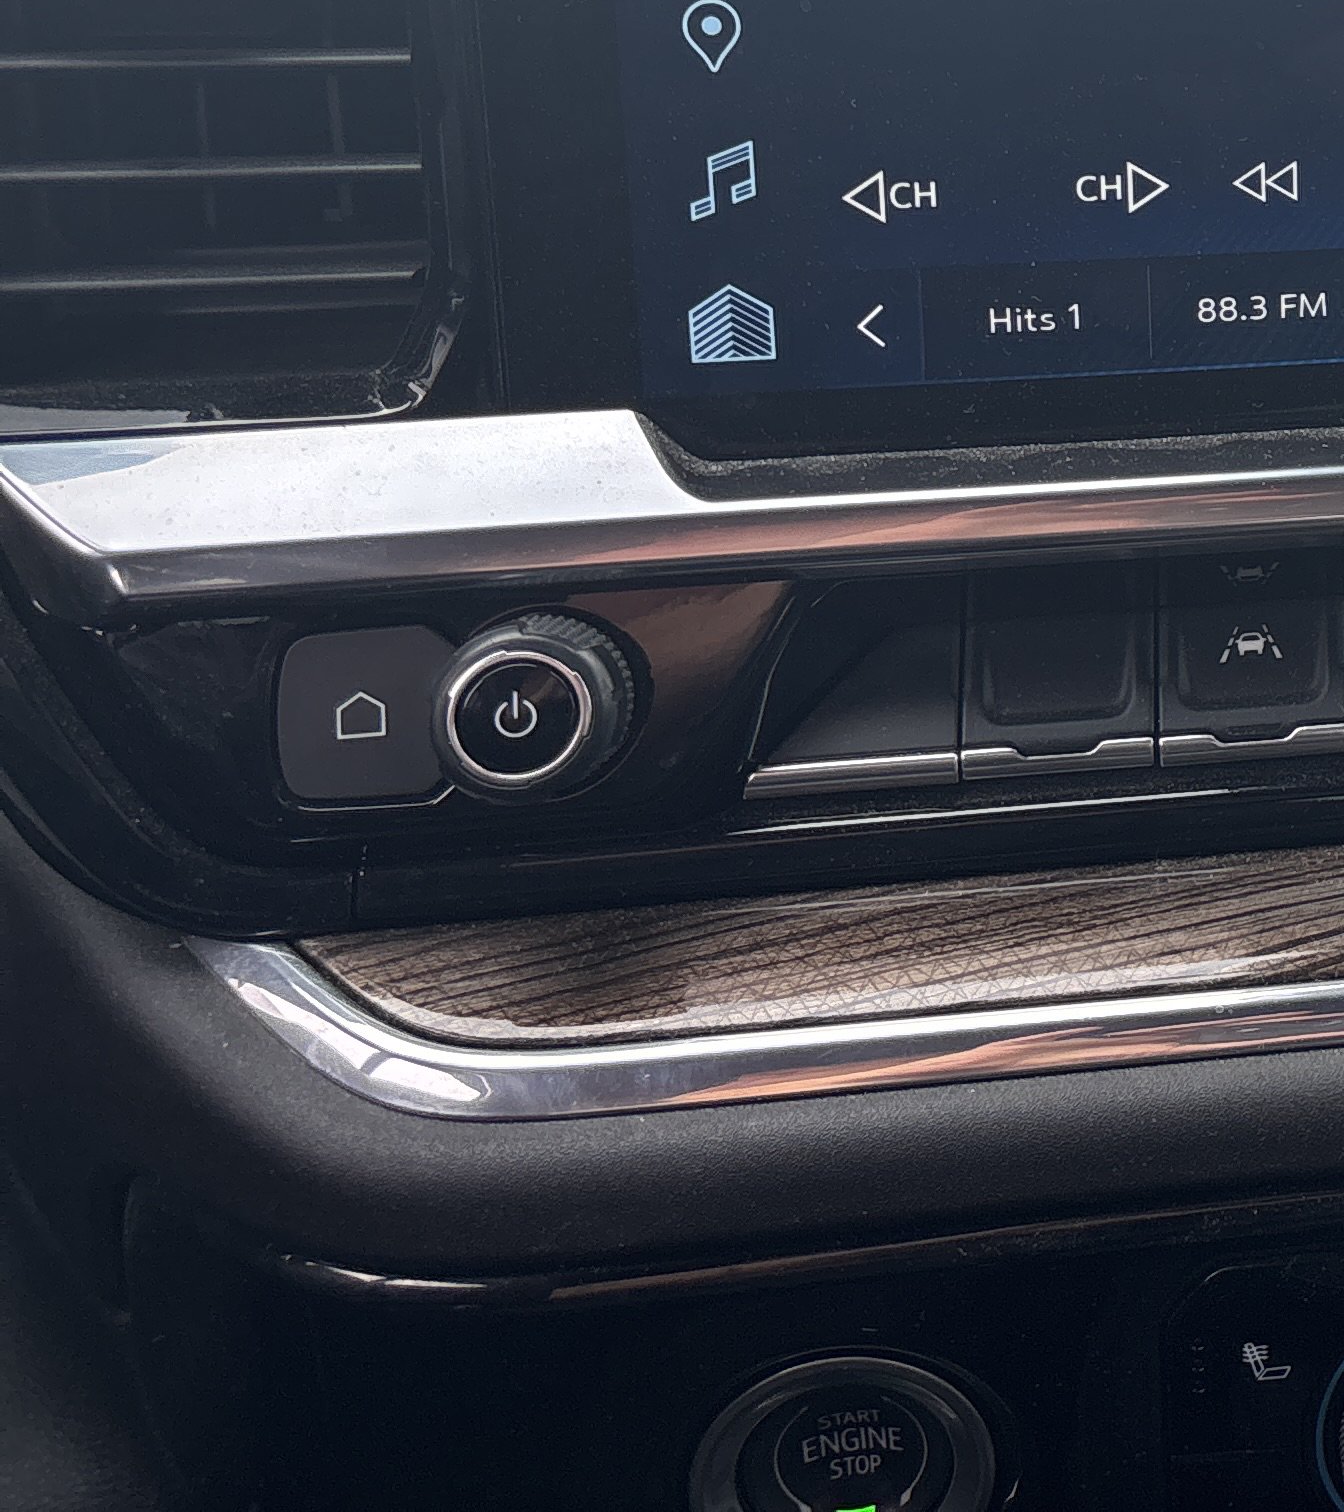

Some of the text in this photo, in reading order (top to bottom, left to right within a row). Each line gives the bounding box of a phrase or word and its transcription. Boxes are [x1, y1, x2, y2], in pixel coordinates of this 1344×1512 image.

[889, 181, 937, 209] CH
[1076, 174, 1123, 202] CH
[989, 303, 1080, 334] Hits 1
[1197, 292, 1327, 323] 88.3 FM
[817, 1409, 881, 1431] START
[801, 1426, 905, 1464] ENGINE
[829, 1454, 882, 1480] STOP
